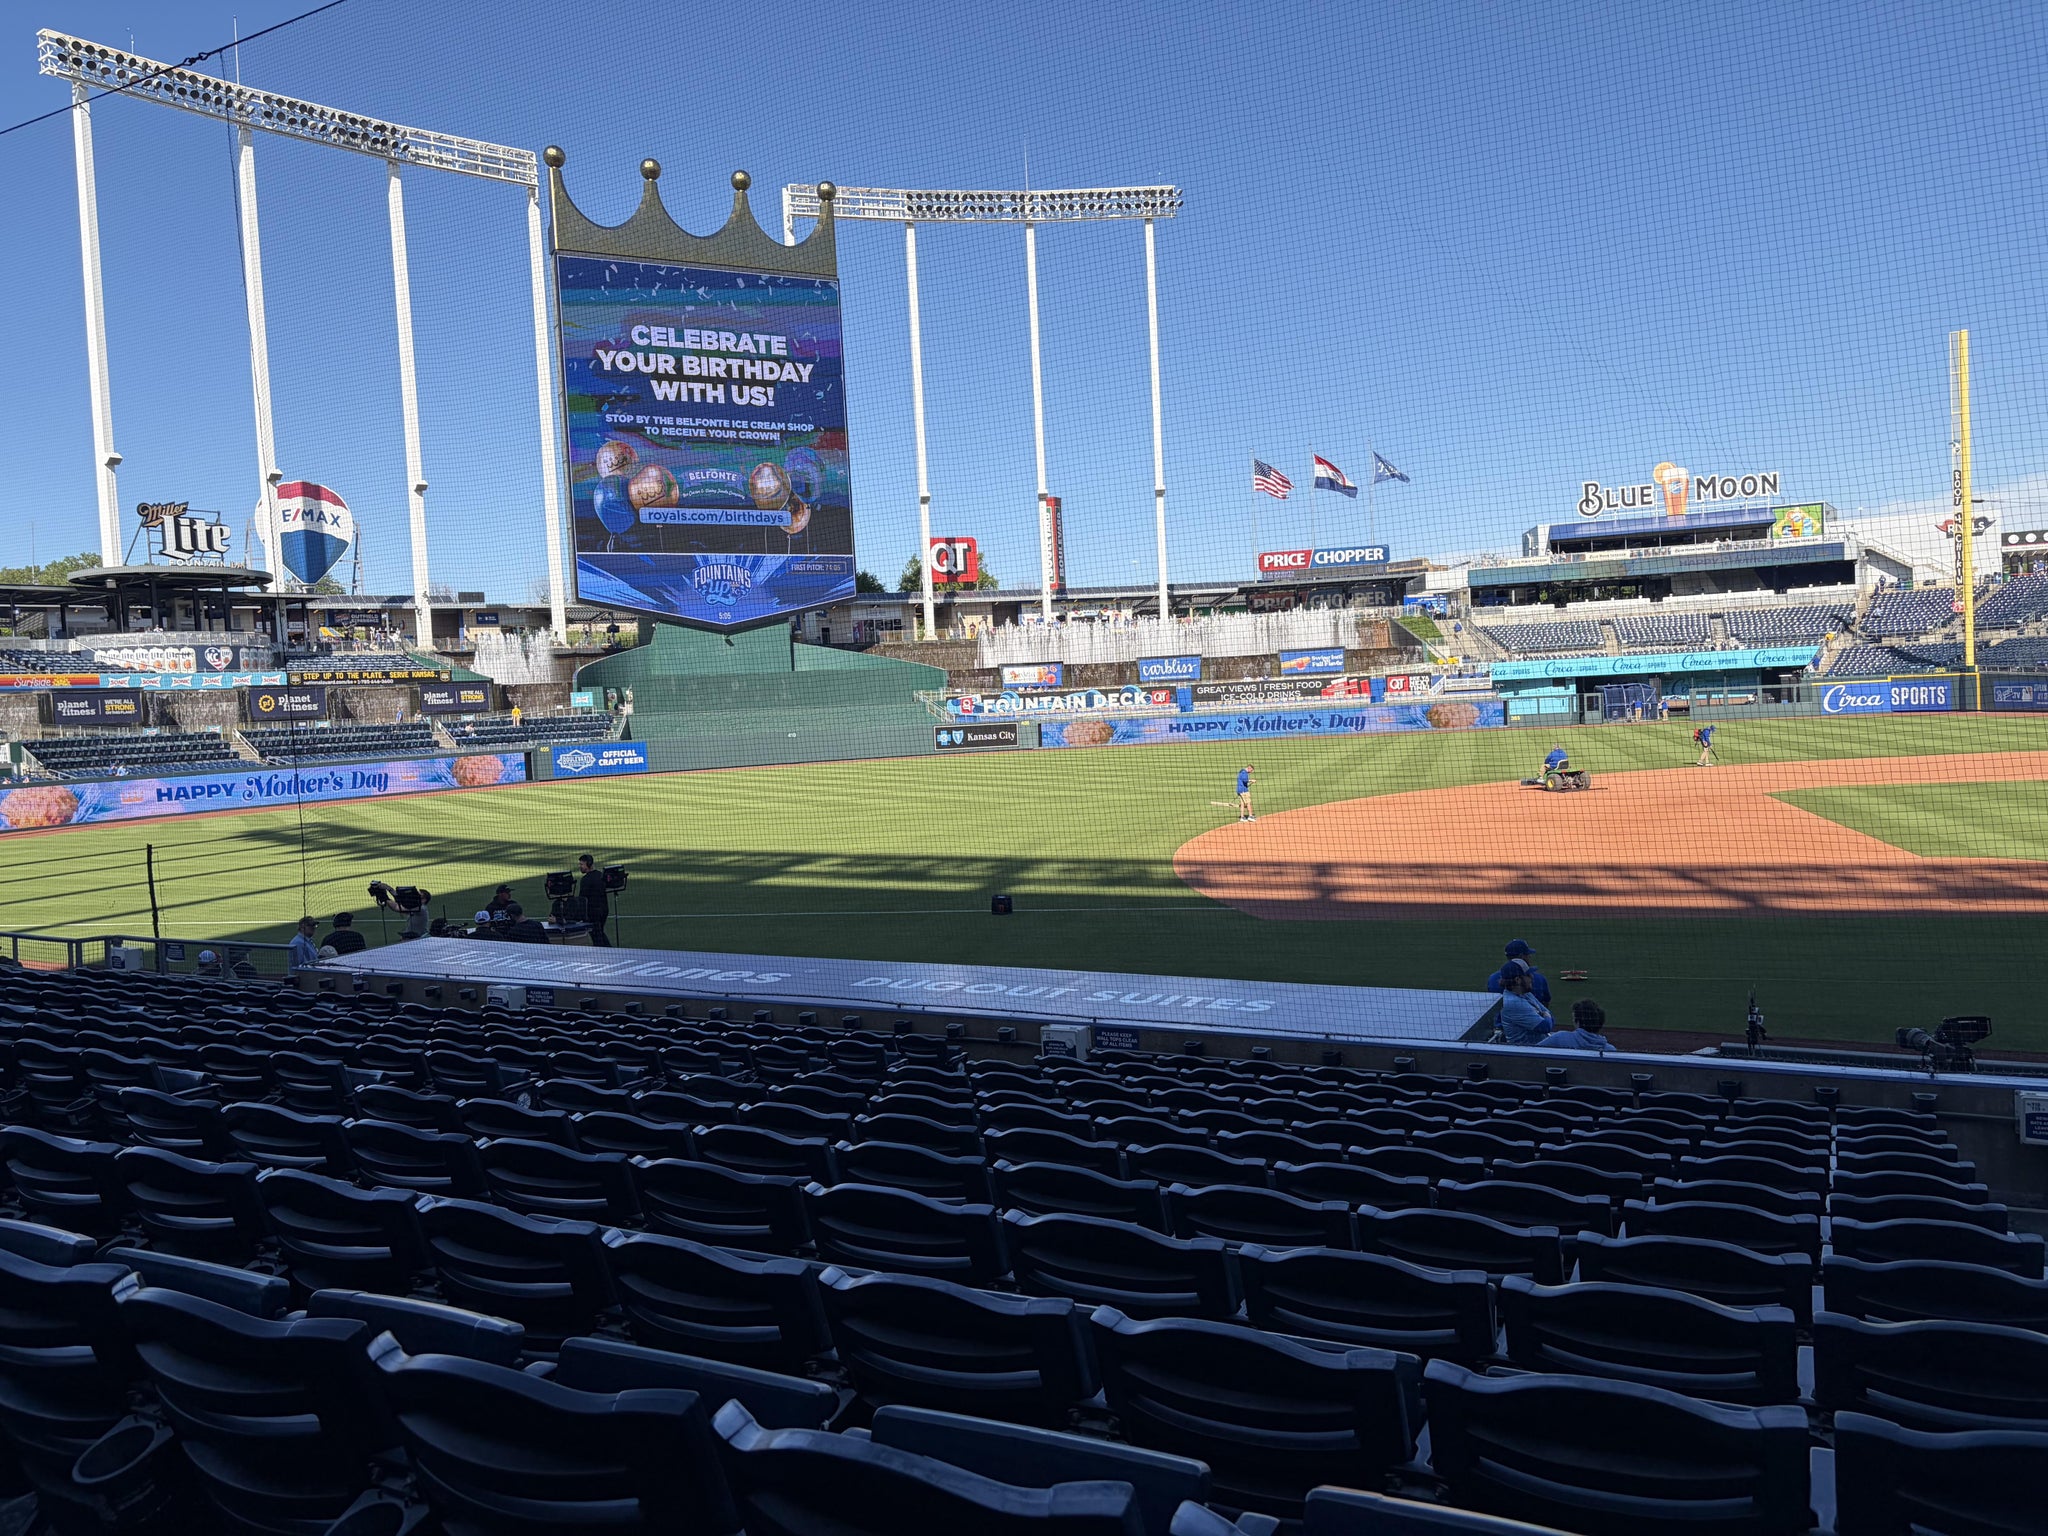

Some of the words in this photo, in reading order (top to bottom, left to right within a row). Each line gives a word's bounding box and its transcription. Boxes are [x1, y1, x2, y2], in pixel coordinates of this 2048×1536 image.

[631, 325, 787, 356] CELEBRATE
[596, 349, 677, 374] YOUR
[683, 355, 814, 383] BIRTHDAY
[650, 380, 725, 404] WITH
[731, 385, 775, 407] US!
[605, 414, 634, 424] STOP
[636, 415, 651, 425] BY
[652, 415, 674, 426] THE
[675, 417, 730, 428] BELFONTE
[731, 420, 748, 429] ICE
[750, 421, 786, 431] CREAM
[787, 422, 814, 432] SHOP
[644, 426, 659, 435] TO
[661, 427, 707, 437] RECEIVE
[708, 429, 736, 439] YOUR
[738, 430, 780, 441] CROWN!
[689, 471, 738, 481] BELFONTE
[1954, 471, 1962, 504] ROOT
[137, 501, 188, 528] Miller
[282, 507, 341, 528] E/MAX
[648, 510, 784, 524] royals.com/birthdays
[160, 514, 231, 560] Lite
[169, 559, 225, 568] FOUNTAIN
[930, 542, 970, 575] QT
[1264, 552, 1306, 568] PRICE
[1314, 547, 1384, 565] CHOPPER
[1955, 533, 1964, 585] CHIKIN
[791, 563, 806, 571] FIRST
[807, 563, 824, 571] PITCH:
[694, 564, 751, 589] FOUNTAINS
[719, 612, 732, 620] 5:05
[1612, 657, 1644, 673] Circa
[1682, 654, 1713, 669] Circa
[1753, 650, 1787, 666] Circa
[1143, 658, 1197, 676] carbliss
[1545, 661, 1575, 676] Circa
[14, 677, 51, 688] Surfside
[1196, 686, 1226, 695] GREAT
[1228, 684, 1258, 693] VIEWS
[1264, 682, 1294, 692] FRESH
[1296, 681, 1322, 690] FOOD
[1390, 678, 1405, 690] QT
[278, 694, 310, 706] planet
[423, 691, 448, 701] planet
[983, 695, 1086, 713] FOUNTAIN
[1094, 691, 1148, 709] DECK
[1153, 691, 1169, 703] QT
[1220, 692, 1265, 701] ICE-COLD
[1266, 690, 1301, 699] DRINKS
[1823, 684, 1885, 713] Circa
[1890, 685, 1946, 706] SPORTS
[57, 700, 89, 711] planet
[62, 707, 96, 716] fitness
[283, 702, 318, 712] fitness
[1168, 721, 1229, 735] HAPPY
[1234, 714, 1322, 736] Mother's
[1328, 713, 1366, 732] Day
[967, 731, 997, 742] Kansas
[998, 730, 1016, 742] City
[598, 758, 623, 766] CRAFT
[624, 757, 644, 765] BEER
[603, 750, 637, 758] OFFICIAL
[156, 782, 236, 802] HAPPY
[242, 771, 344, 800] Mother's
[351, 771, 389, 793] Day
[595, 960, 792, 984] Jones
[850, 976, 1078, 1000] DUGOUT
[1082, 990, 1276, 1012] SUITES
